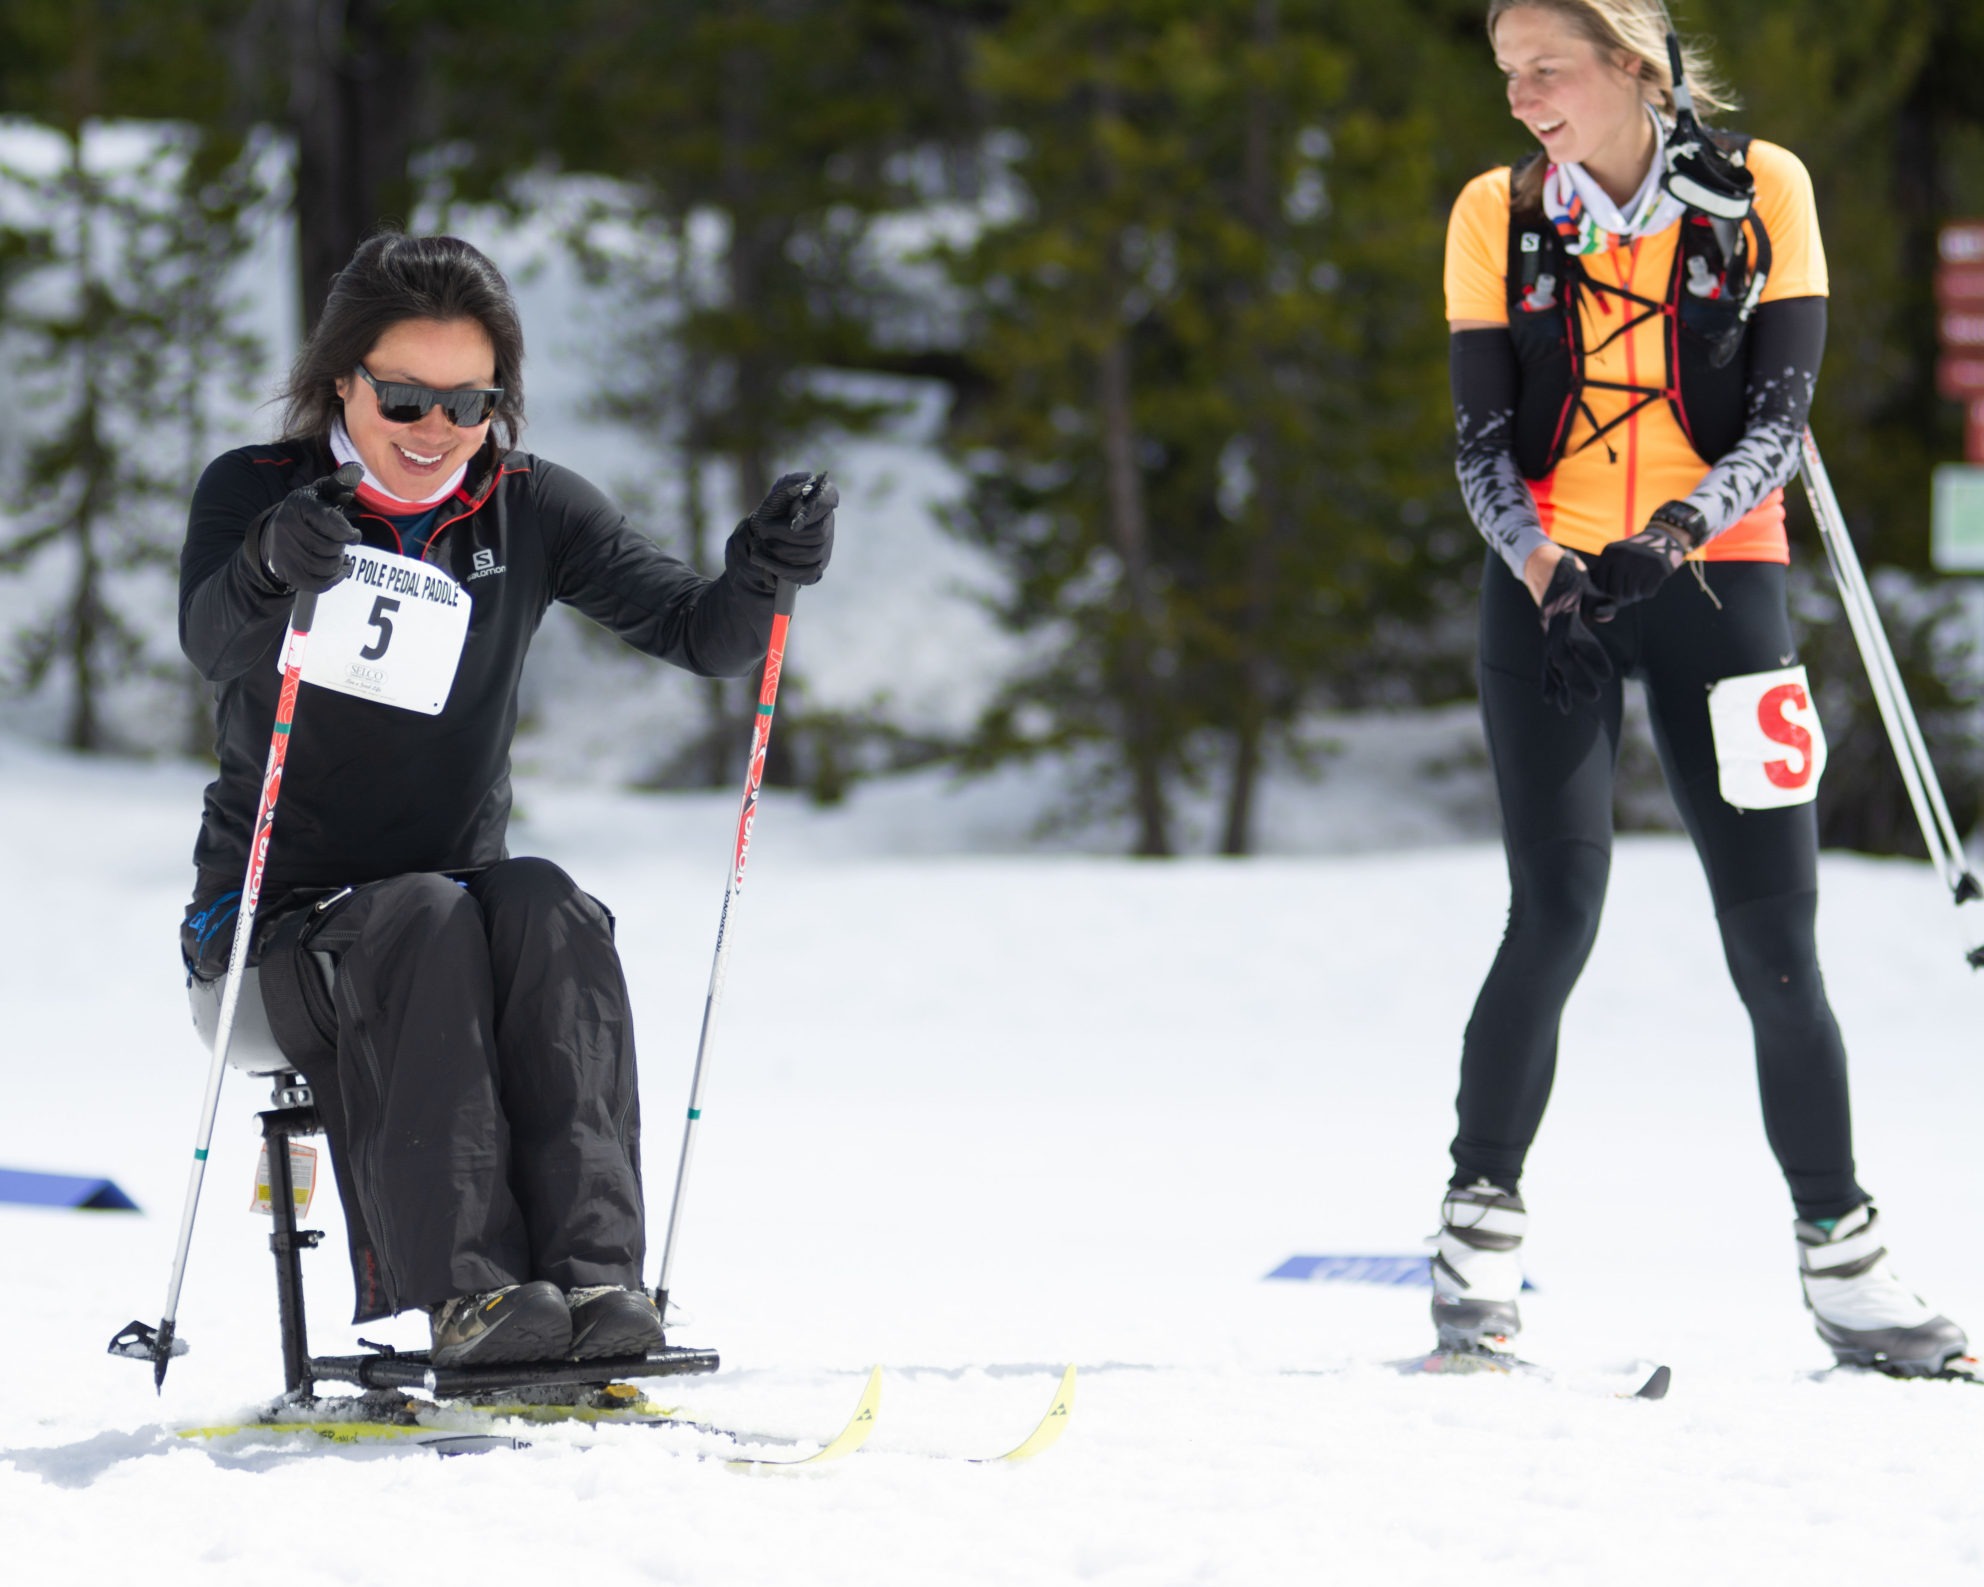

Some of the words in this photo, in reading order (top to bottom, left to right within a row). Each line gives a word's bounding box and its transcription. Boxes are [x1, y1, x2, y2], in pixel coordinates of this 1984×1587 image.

[356, 558, 388, 588] POLE
[386, 566, 420, 598] PEDAL
[421, 576, 459, 607] PADDLE
[359, 595, 401, 661] 5
[1757, 683, 1812, 789] S
[250, 837, 270, 902] TOUR
